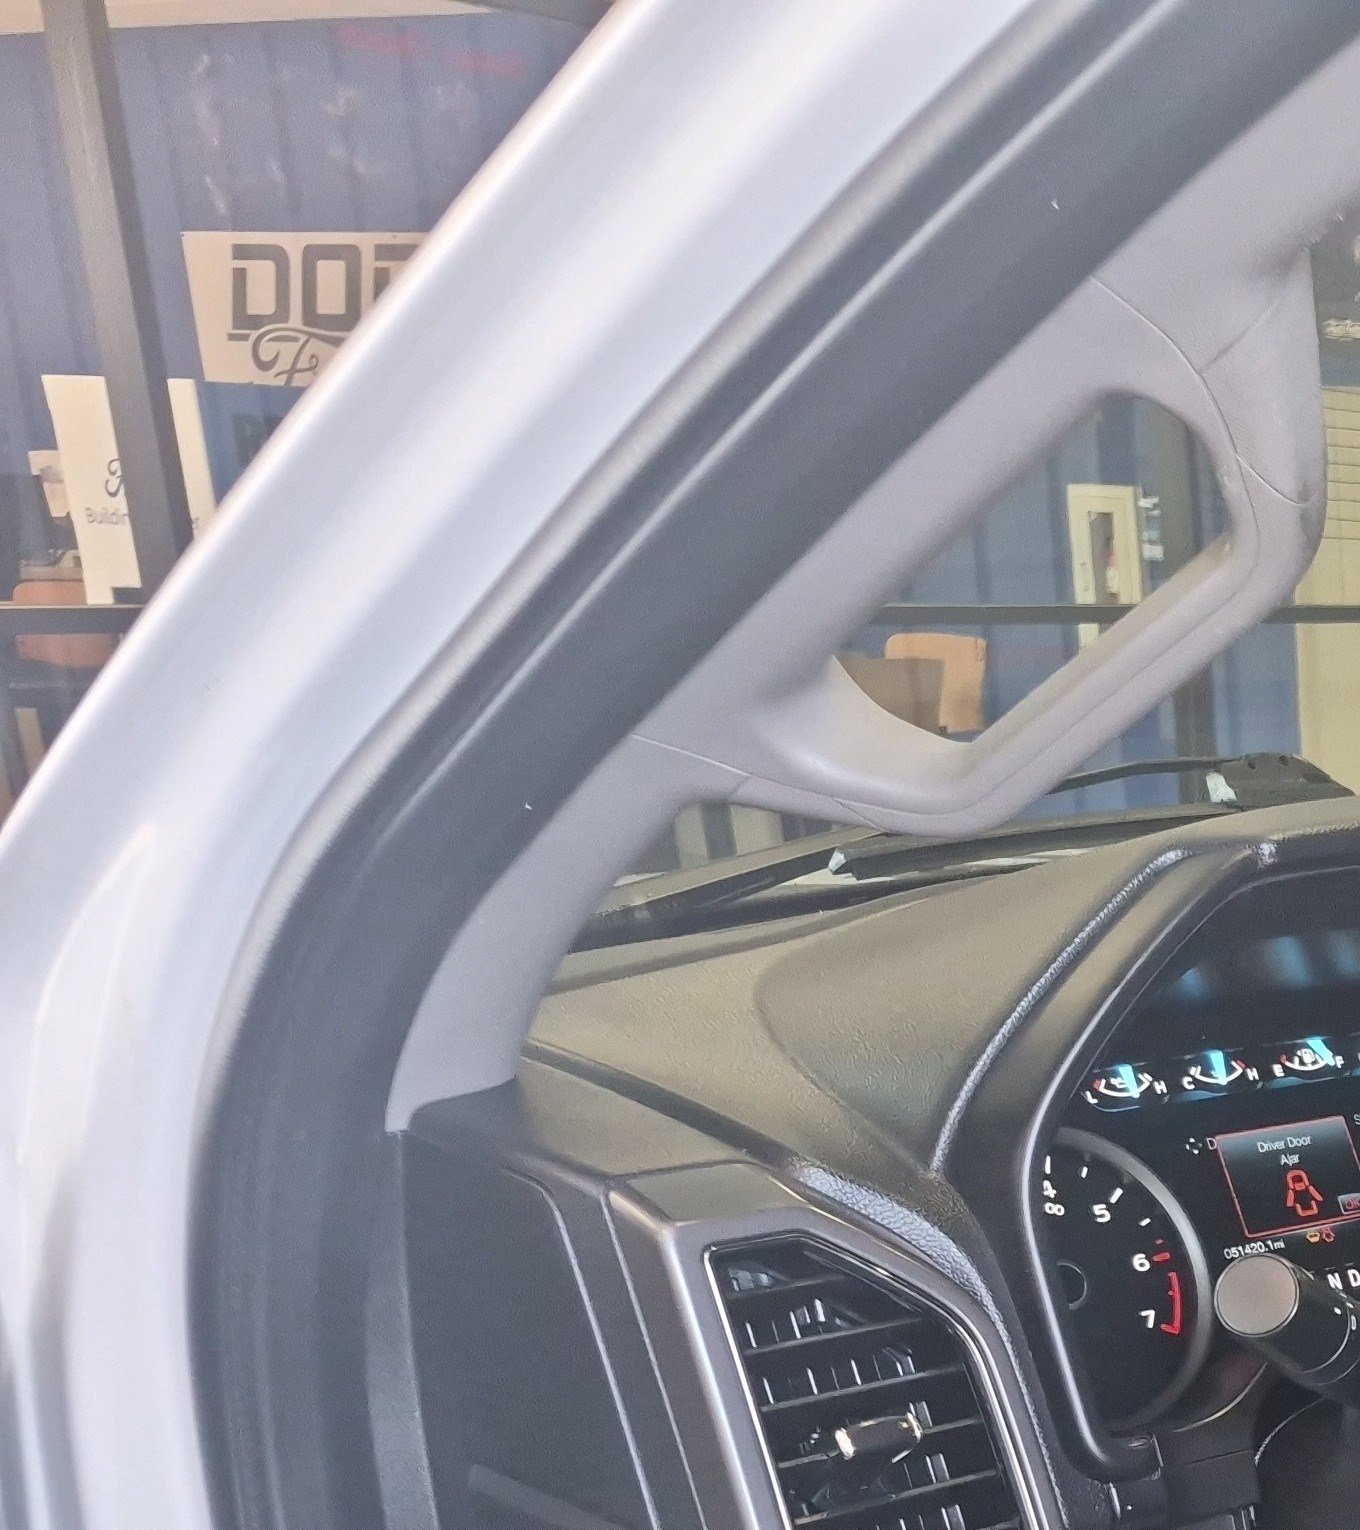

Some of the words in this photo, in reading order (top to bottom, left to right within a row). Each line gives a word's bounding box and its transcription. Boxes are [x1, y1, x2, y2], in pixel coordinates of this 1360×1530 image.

[1272, 1064, 1285, 1077] E
[1335, 1055, 1345, 1068] F
[1153, 1080, 1168, 1095] H
[1182, 1076, 1196, 1090] C
[1246, 1067, 1260, 1081] H
[1257, 1140, 1286, 1154] Driver
[1286, 1135, 1312, 1149] Door
[1280, 1153, 1301, 1167] Ajar
[1043, 1179, 1057, 1199] 4
[1092, 1203, 1111, 1223] 5
[1132, 1253, 1151, 1272] 6
[1326, 1272, 1344, 1291] N
[1139, 1309, 1156, 1329] 7
